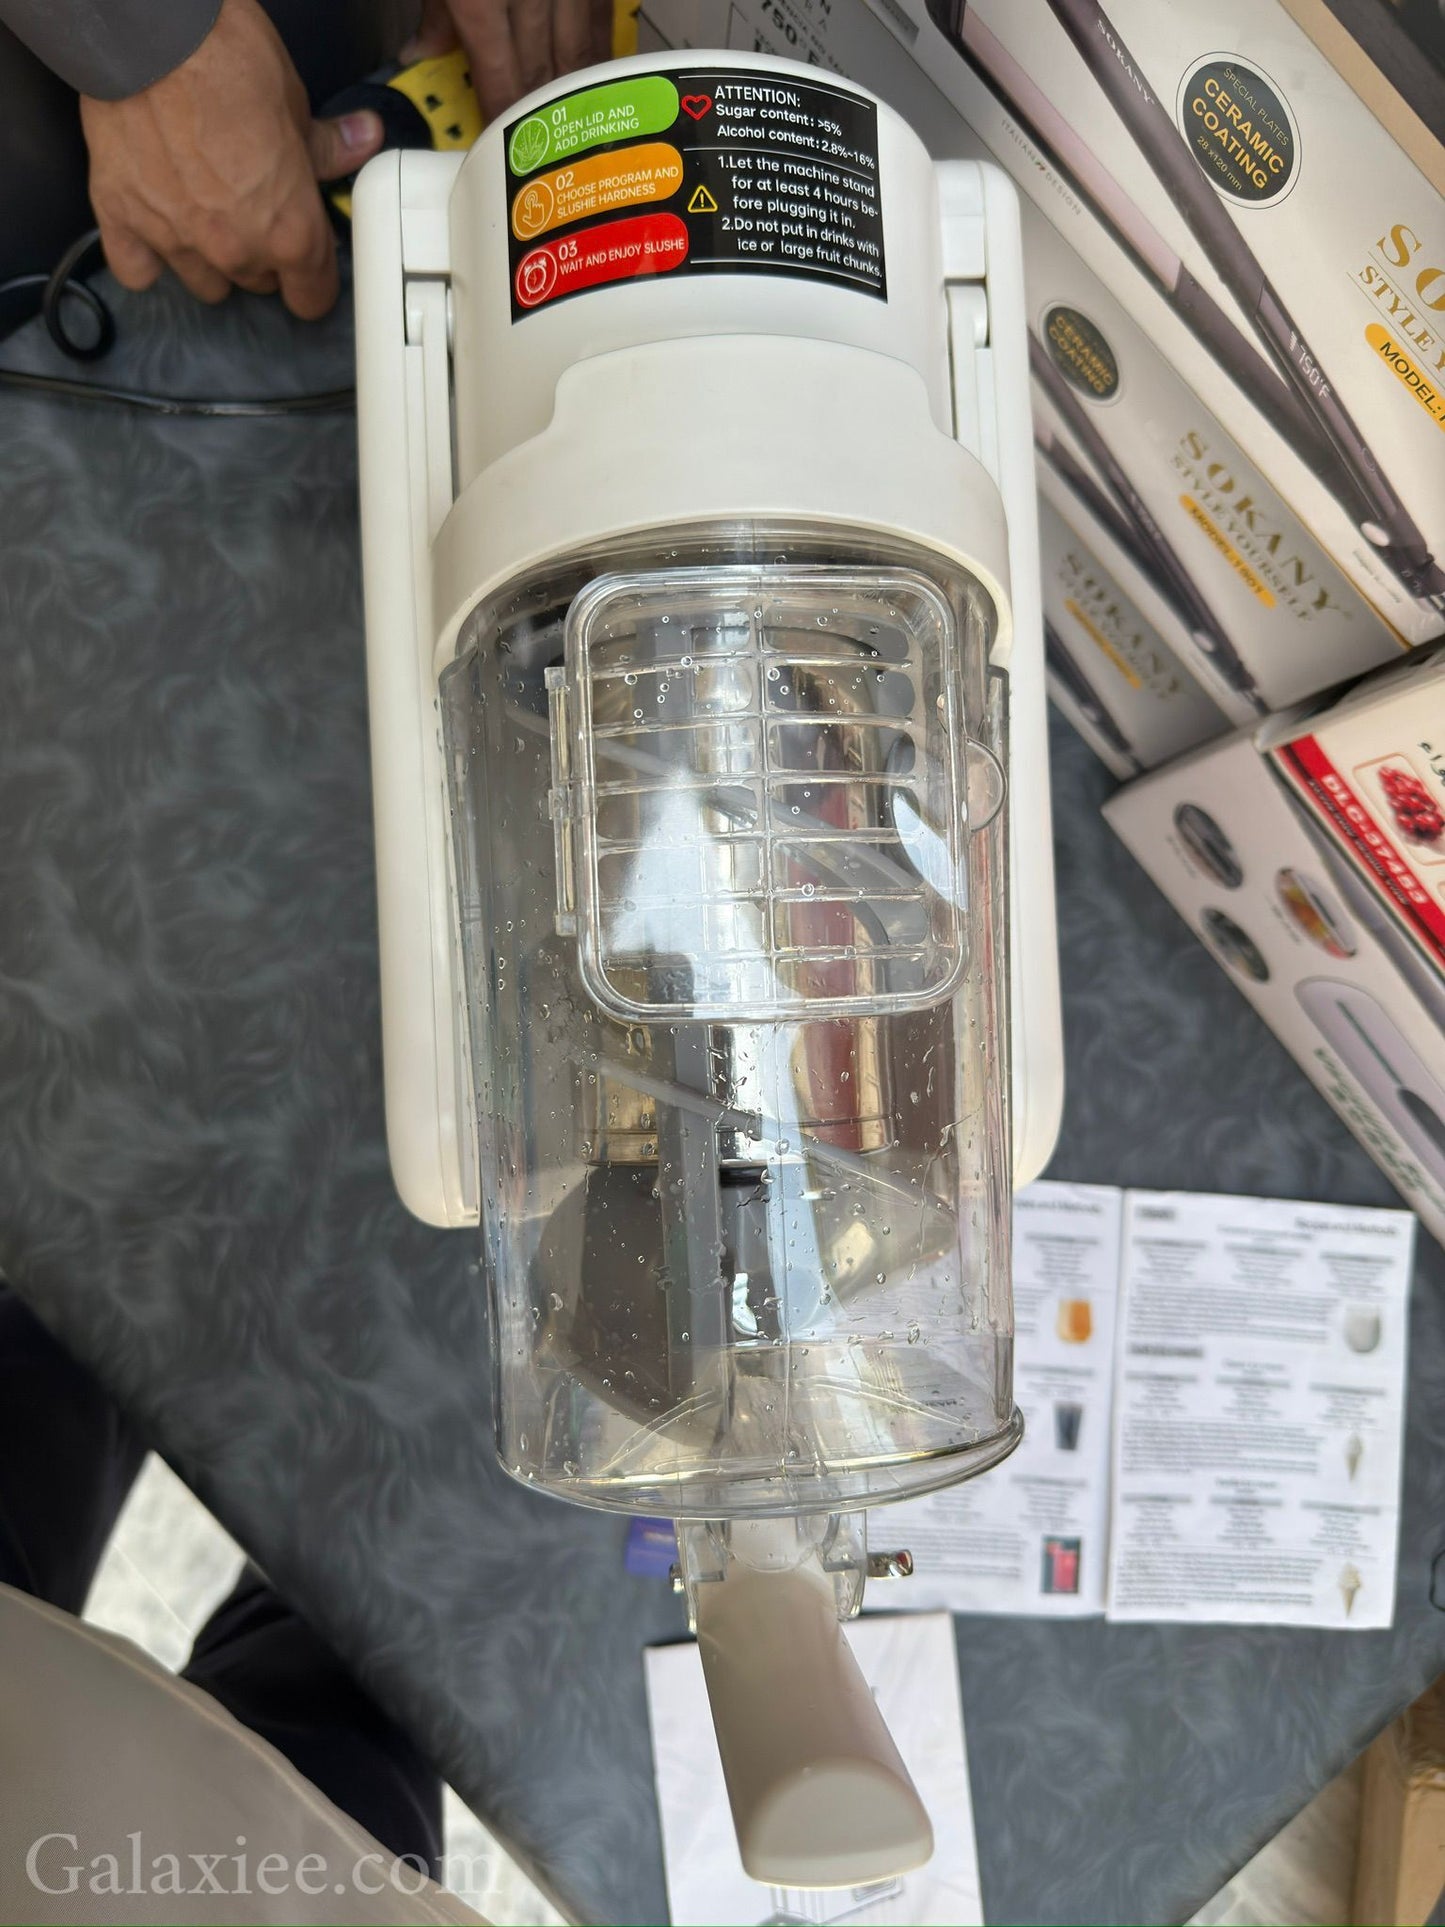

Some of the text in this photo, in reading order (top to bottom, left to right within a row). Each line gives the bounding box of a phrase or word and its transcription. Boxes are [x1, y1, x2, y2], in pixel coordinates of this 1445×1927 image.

[1097, 19, 1150, 103] SOKANY
[552, 106, 567, 126] 01
[715, 85, 800, 107] ATTENTION:
[1223, 68, 1289, 146] SPECIAL PLATES
[554, 105, 634, 138] OPEN LID AND
[555, 118, 639, 152] ADD DRINKING
[716, 103, 756, 118] Sugar
[817, 119, 842, 137] >5%
[717, 125, 765, 139] Alcohol
[1204, 78, 1284, 174] CERAMIC
[1192, 97, 1268, 189] COATING
[1197, 135, 1209, 150] 28
[1227, 171, 1242, 191] mm
[556, 171, 574, 190] 02
[557, 166, 678, 205] CHOOSE PROGRAM AND
[718, 155, 875, 199] 1.Let the machine stand
[1000, 119, 1081, 215] ITALIAN DESIGN
[557, 183, 656, 219] SLUSHIE HARDNESS
[731, 176, 878, 217] for at least 4 hours be-
[733, 196, 856, 229] fore plugging it in.
[559, 240, 578, 261] 03
[560, 238, 685, 275] WAIT AND ENJOY SLUSHE
[722, 217, 879, 258] 2.Do not put in drinks with
[737, 238, 882, 278] ice or large fruit chunks.
[1359, 265, 1435, 352] STYLE
[1049, 324, 1106, 393] COATING
[1056, 316, 1113, 385] CERAMIC
[1380, 341, 1442, 414] MODEL:
[1170, 455, 1312, 621] STYLE YOURSELF
[1179, 431, 1353, 621] SOKANY
